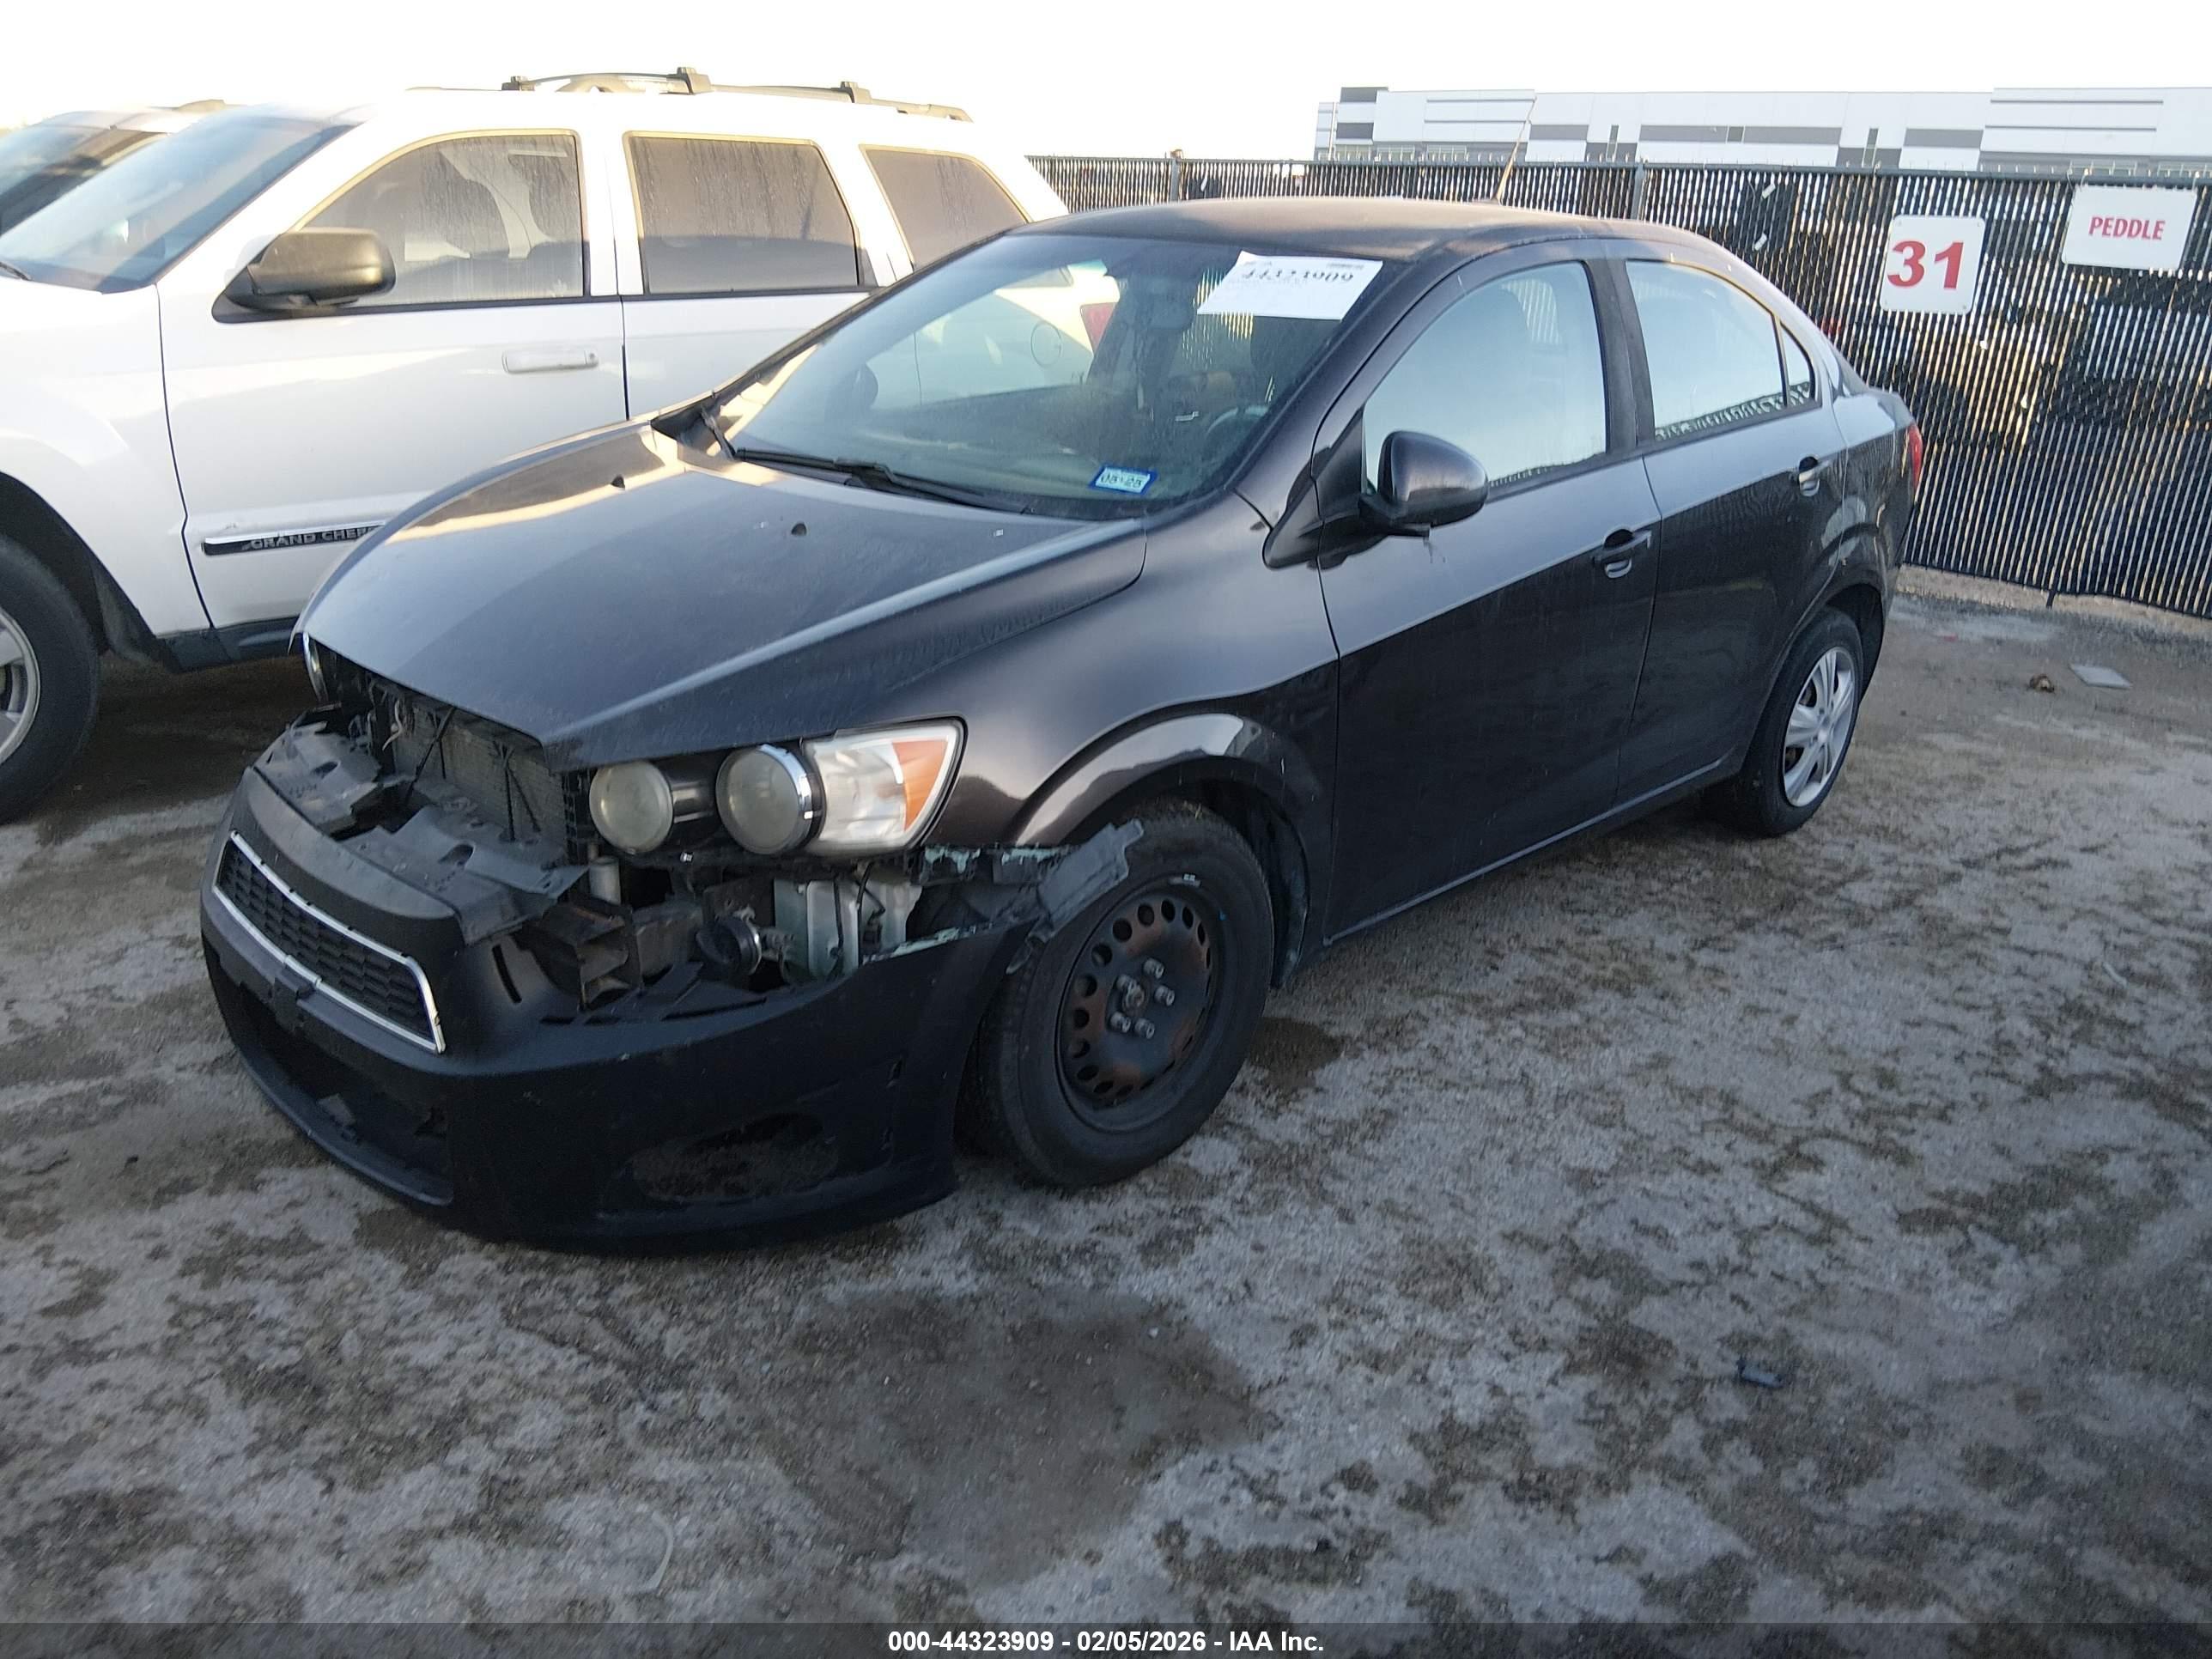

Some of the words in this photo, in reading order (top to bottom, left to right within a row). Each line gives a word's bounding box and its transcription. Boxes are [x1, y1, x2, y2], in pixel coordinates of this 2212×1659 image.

[2087, 216, 2166, 240] PEDDLE
[1887, 240, 1964, 290] 31
[250, 532, 317, 550] GRAND
